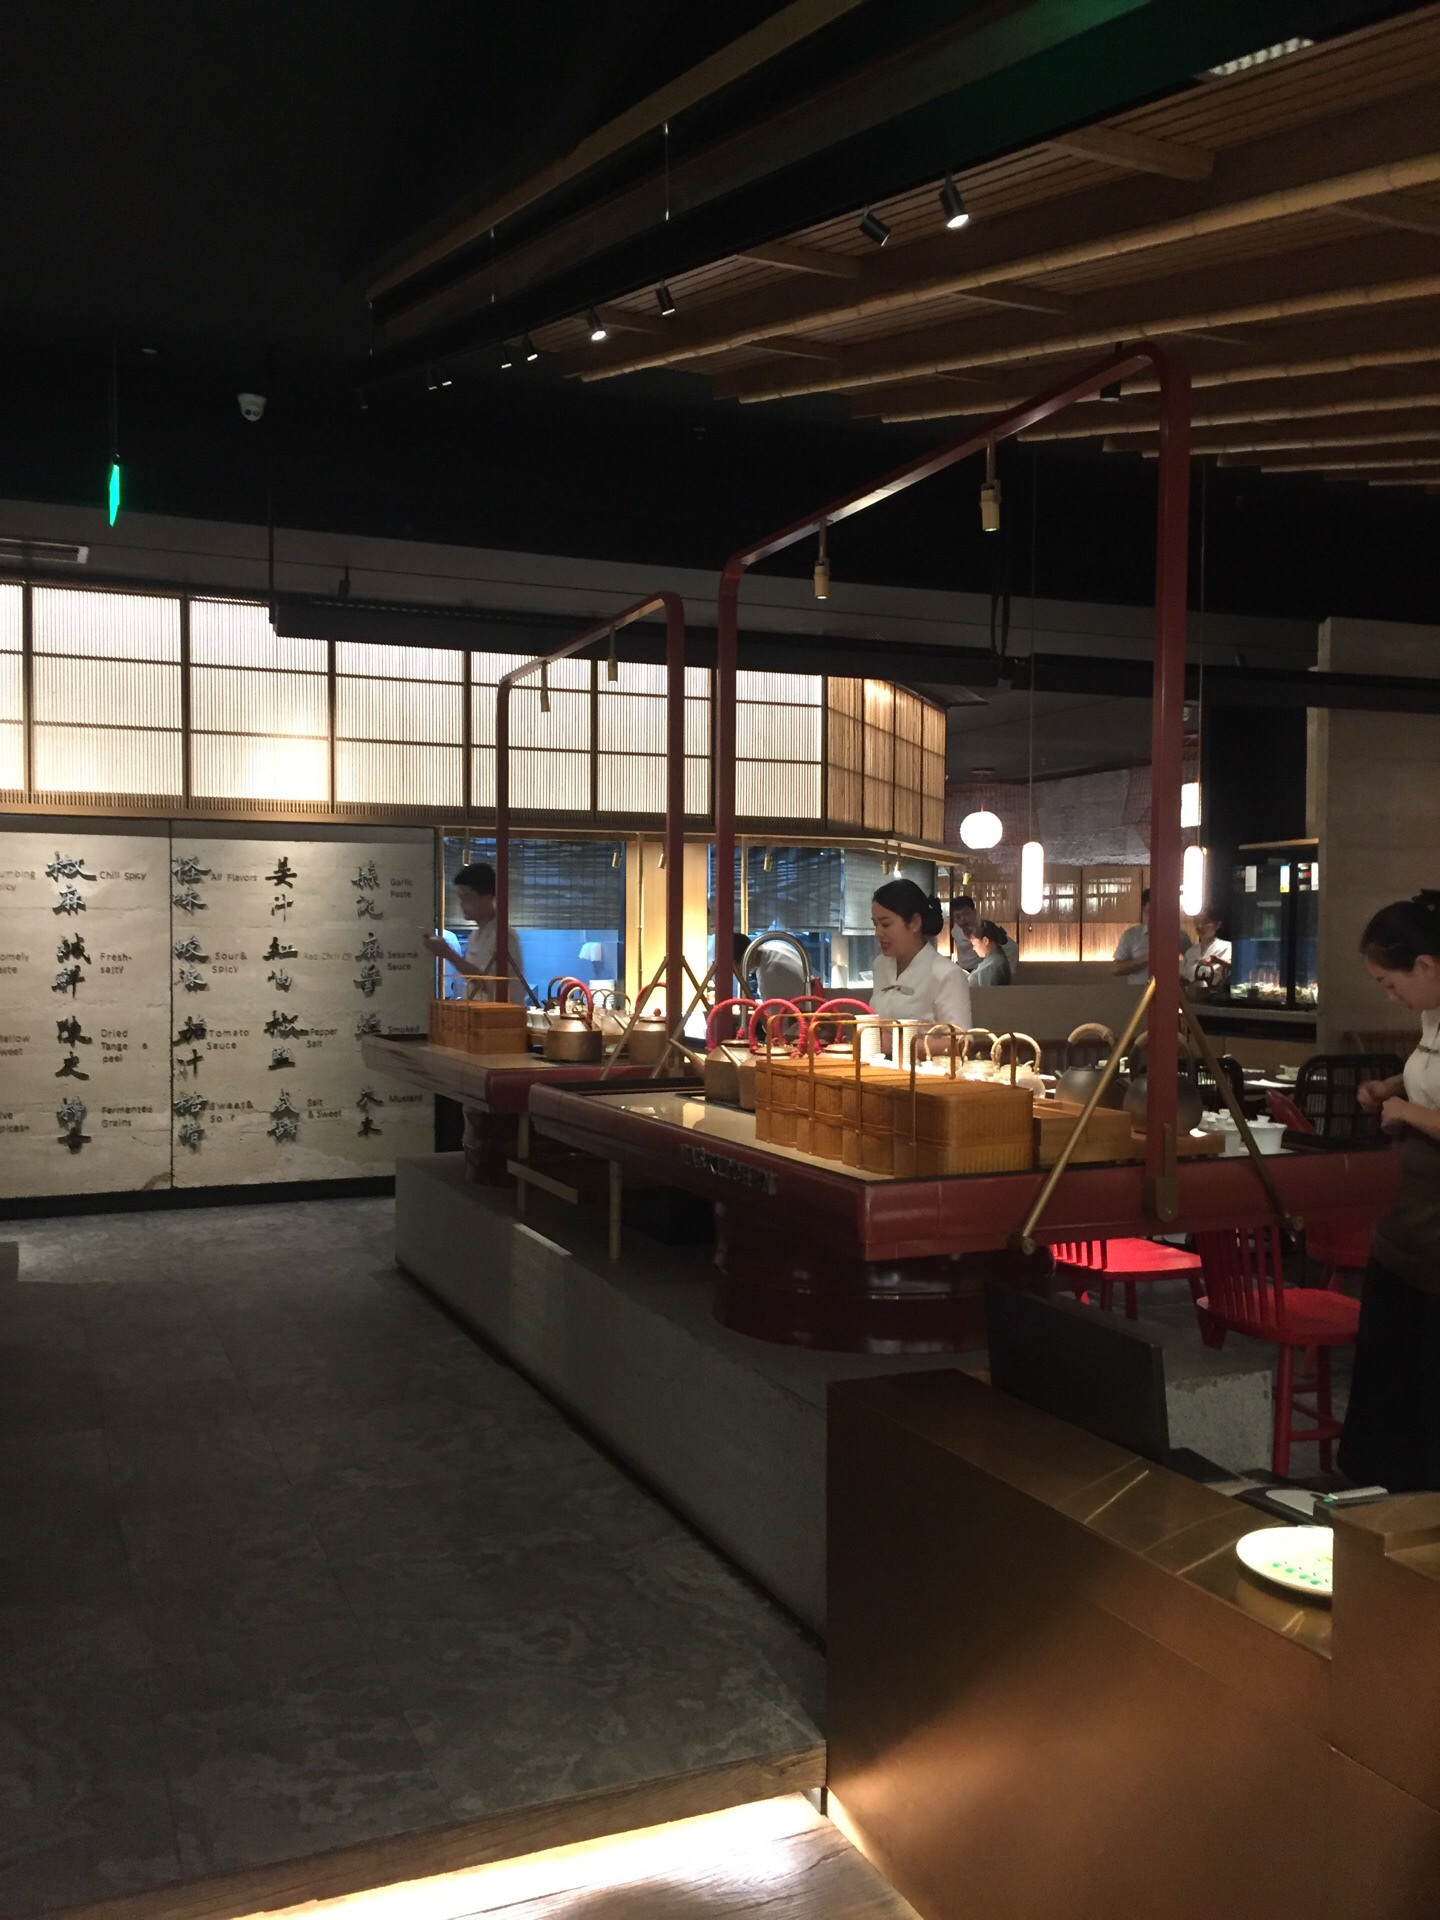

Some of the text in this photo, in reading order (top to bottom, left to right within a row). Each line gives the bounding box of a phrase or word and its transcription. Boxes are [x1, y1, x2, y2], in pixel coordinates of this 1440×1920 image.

[227, 873, 258, 882] Flavors
[172, 855, 211, 915] 怪味
[390, 878, 414, 887] Garlic
[390, 890, 412, 898] Paste
[387, 951, 418, 959] Sesame
[174, 934, 211, 993] 酸辣
[387, 962, 411, 971] Sauce
[101, 1029, 128, 1038] Dried
[208, 1028, 250, 1037] Tomato
[309, 1028, 338, 1037] Pepper
[387, 1025, 420, 1034] Smoked
[173, 1014, 206, 1081] 茄汁
[206, 1042, 237, 1050] Sauce
[307, 1040, 323, 1048] Salt
[307, 1098, 323, 1107] Salt
[388, 1094, 423, 1103] Mustard
[101, 1105, 153, 1115] Fermented
[317, 1109, 342, 1119] Sweet
[101, 1119, 132, 1128] Grains
[173, 1093, 208, 1154] 糖醋
